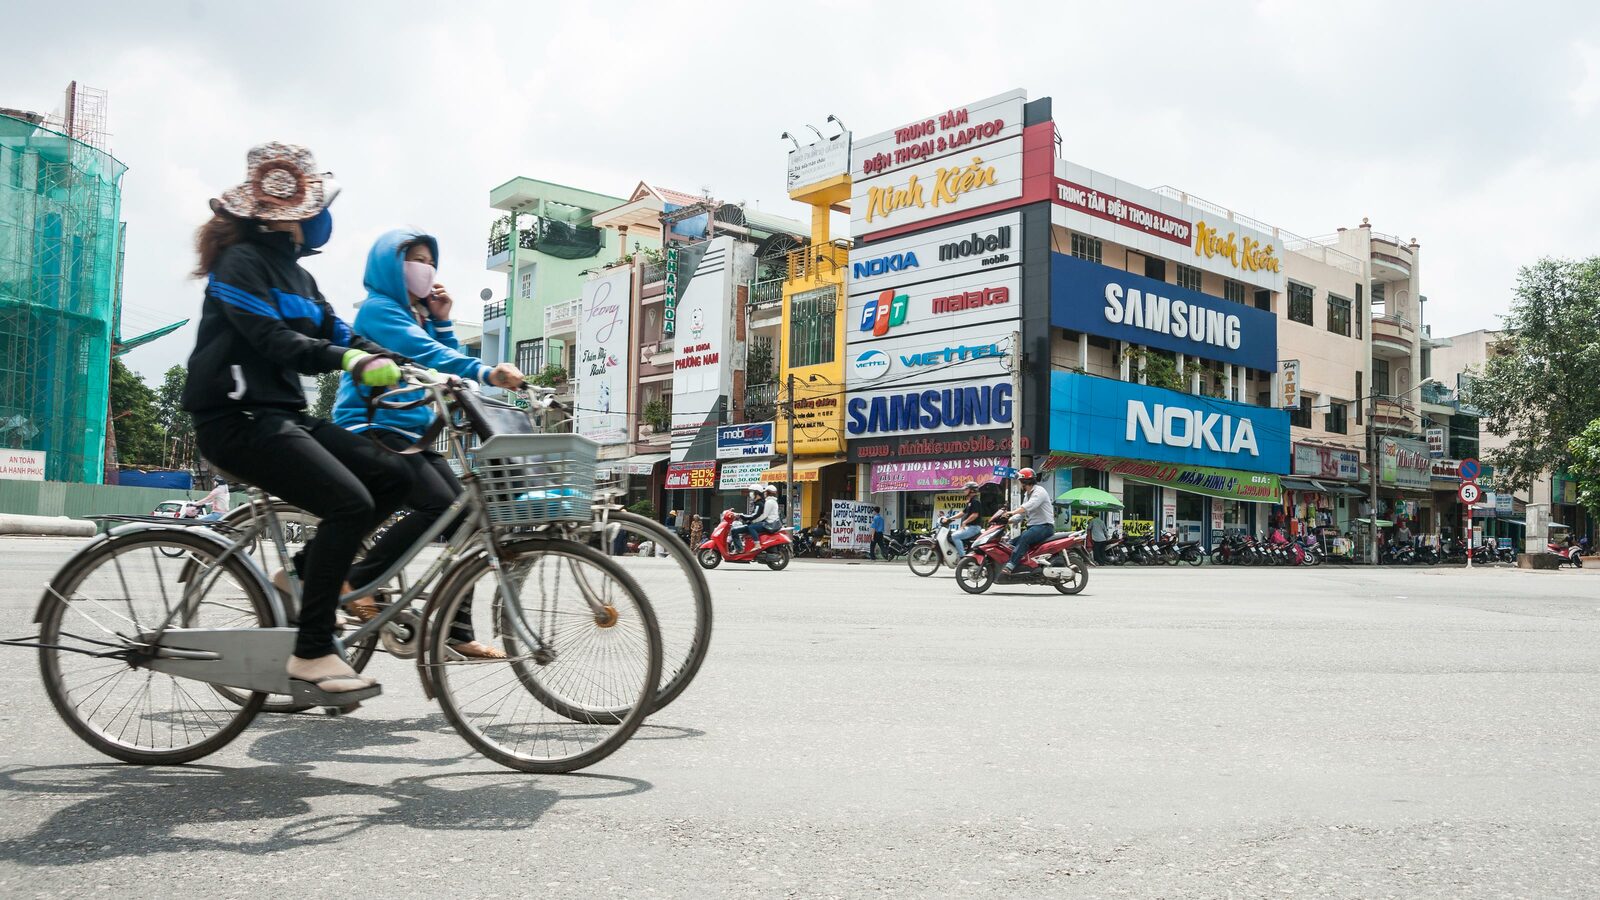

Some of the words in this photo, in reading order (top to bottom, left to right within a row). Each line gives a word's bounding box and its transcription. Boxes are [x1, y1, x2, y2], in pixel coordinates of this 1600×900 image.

[895, 118, 935, 145] TRUNG
[939, 107, 968, 131] TÂM
[863, 151, 891, 175] ĐIỆN
[893, 140, 934, 164] THOẠI
[936, 138, 946, 152] &
[948, 119, 1004, 149] LAPTOP
[866, 175, 924, 223] Ninh
[1057, 183, 1086, 207] TRUNG
[1087, 191, 1106, 213] TÂM
[1107, 199, 1127, 221] ĐIỆN
[1128, 207, 1153, 230] THOẠI
[1153, 216, 1160, 230] &
[1160, 217, 1189, 240] LAPTOP
[939, 225, 1011, 262] mobell
[982, 254, 1010, 267] mobile
[1195, 220, 1239, 268] Ninh
[853, 251, 920, 279] NOKIA
[862, 302, 904, 324] FPT
[932, 286, 1010, 314] malata
[1104, 282, 1241, 350] SAMSUNG
[695, 343, 711, 352] KHOA
[703, 353, 719, 365] NAM
[847, 382, 1013, 435] SAMSUNG
[1126, 399, 1259, 457] NOKIA
[901, 461, 932, 473] THOẠI
[934, 461, 941, 470] 2
[942, 460, 962, 470] SIM
[964, 459, 971, 468] 2
[1465, 488, 1474, 498] 5t
